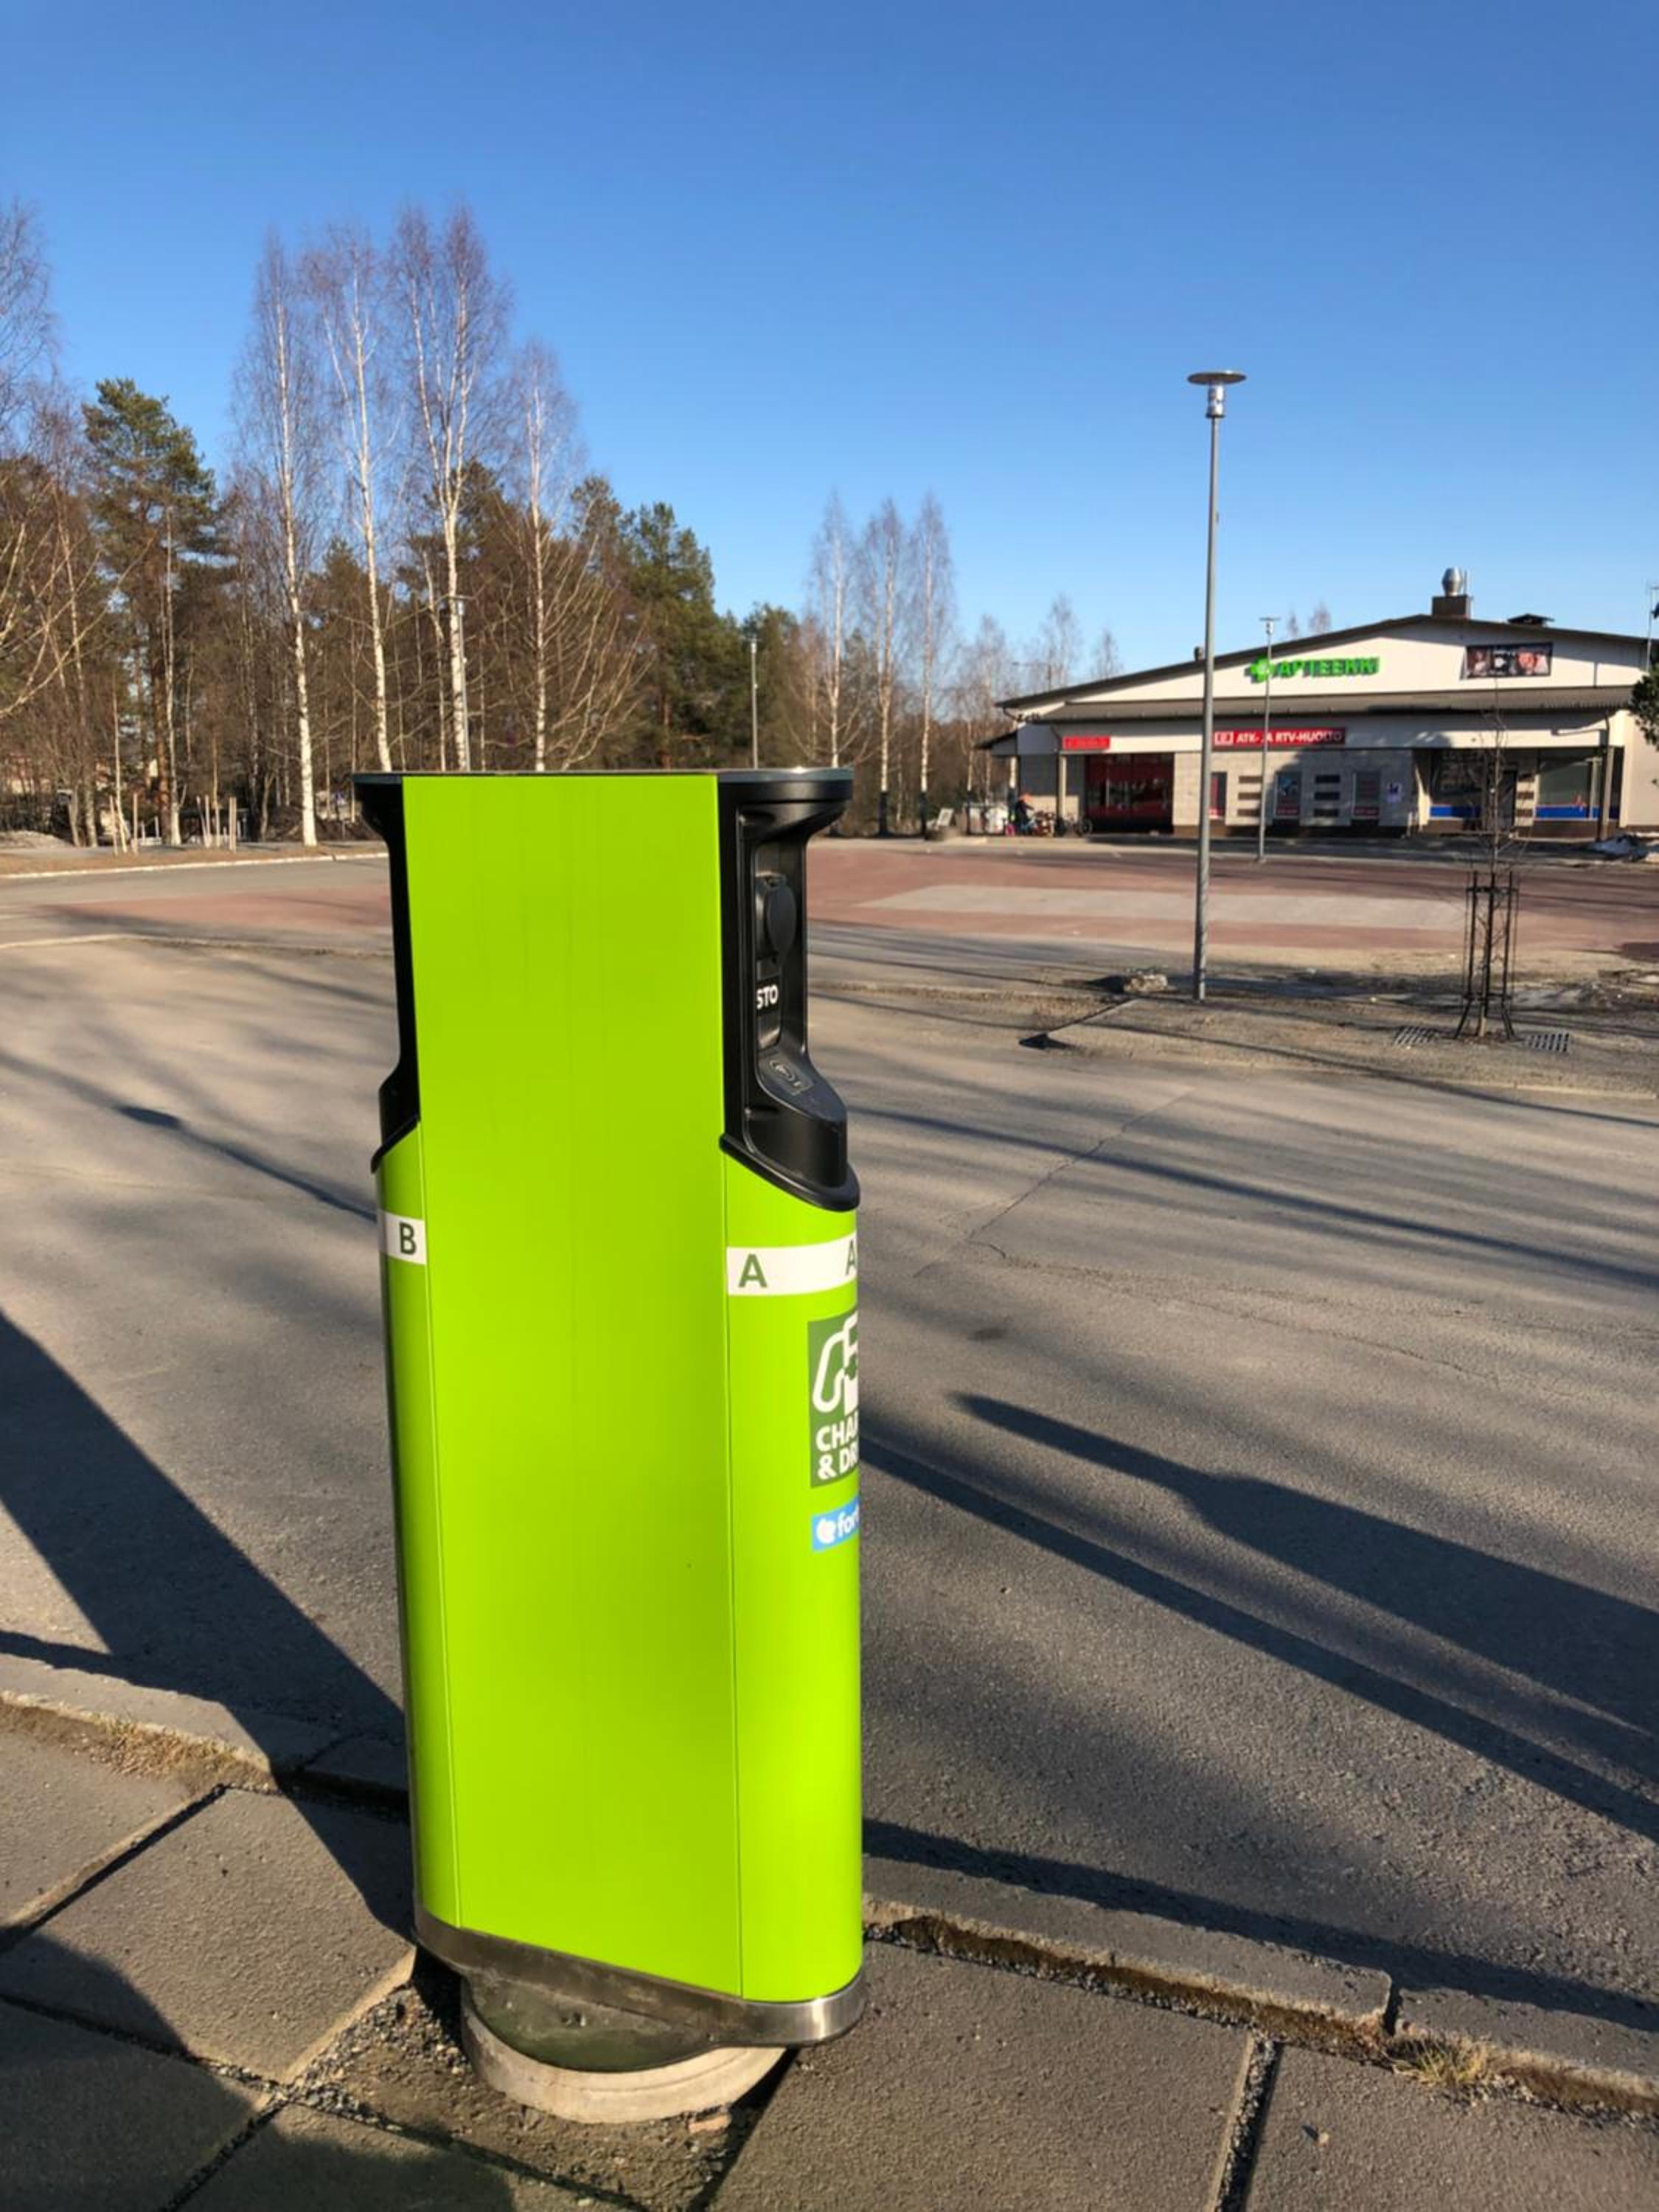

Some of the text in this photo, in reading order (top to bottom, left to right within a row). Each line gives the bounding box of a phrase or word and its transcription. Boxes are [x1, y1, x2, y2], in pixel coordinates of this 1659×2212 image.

[757, 984, 779, 1010] STO
[399, 1222, 417, 1255] B
[739, 1239, 858, 1288] A A
[817, 1453, 838, 1481] &
